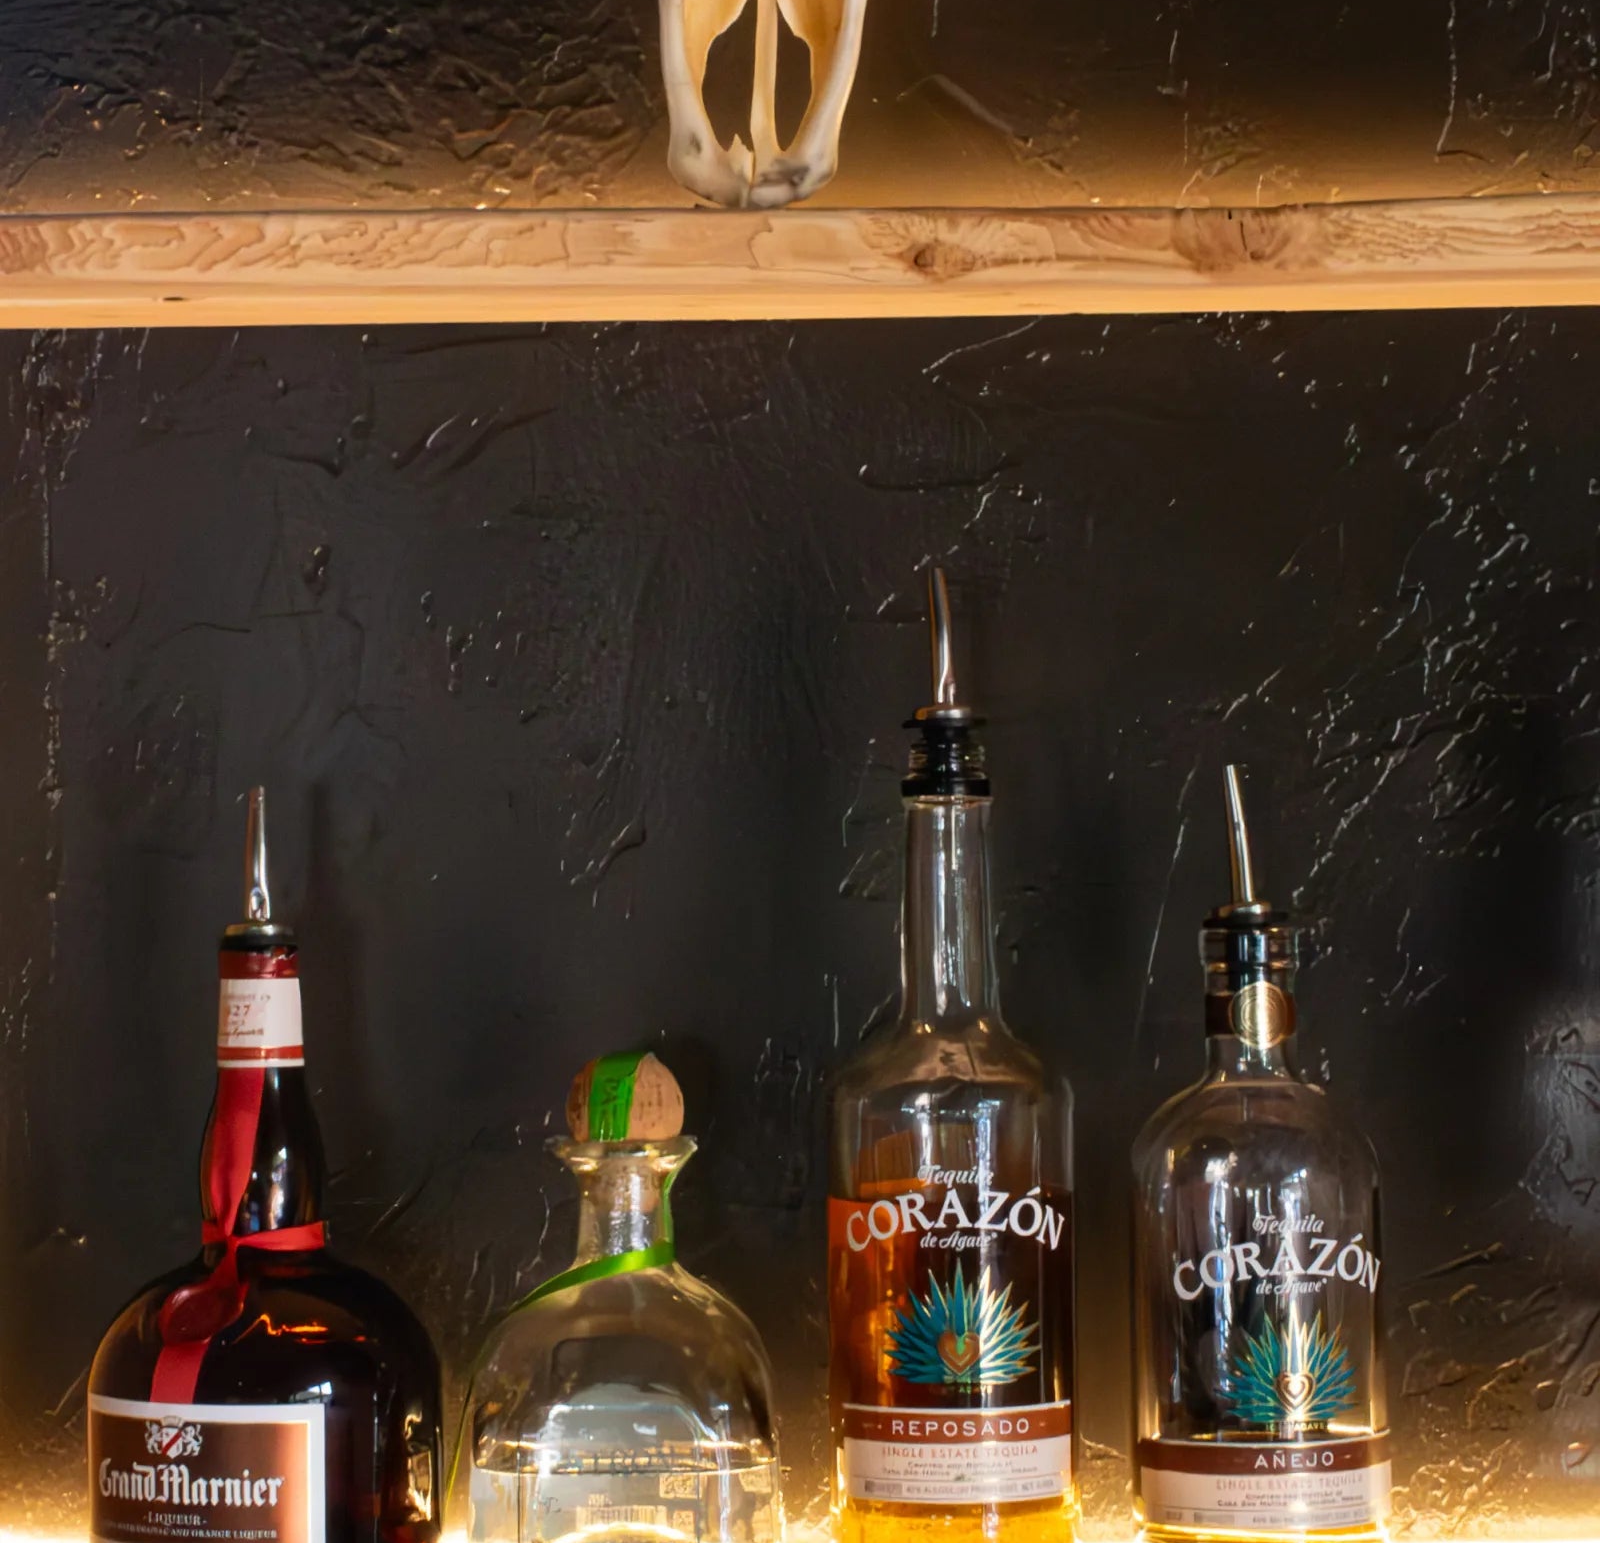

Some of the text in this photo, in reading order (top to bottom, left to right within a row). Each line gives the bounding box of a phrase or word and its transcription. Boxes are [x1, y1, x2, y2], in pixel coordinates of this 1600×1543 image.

[917, 1164, 994, 1190] Tequila
[846, 1185, 1064, 1252] CORAZÓN
[1252, 1214, 1324, 1235] Tequila
[920, 1231, 938, 1249] de
[1173, 1233, 1381, 1300] CORAZÓN
[1255, 1279, 1272, 1295] de
[891, 1417, 1030, 1437] REPOSADO
[1254, 1451, 1335, 1470] AÑEJO
[99, 1458, 284, 1507] Grand Marnier
